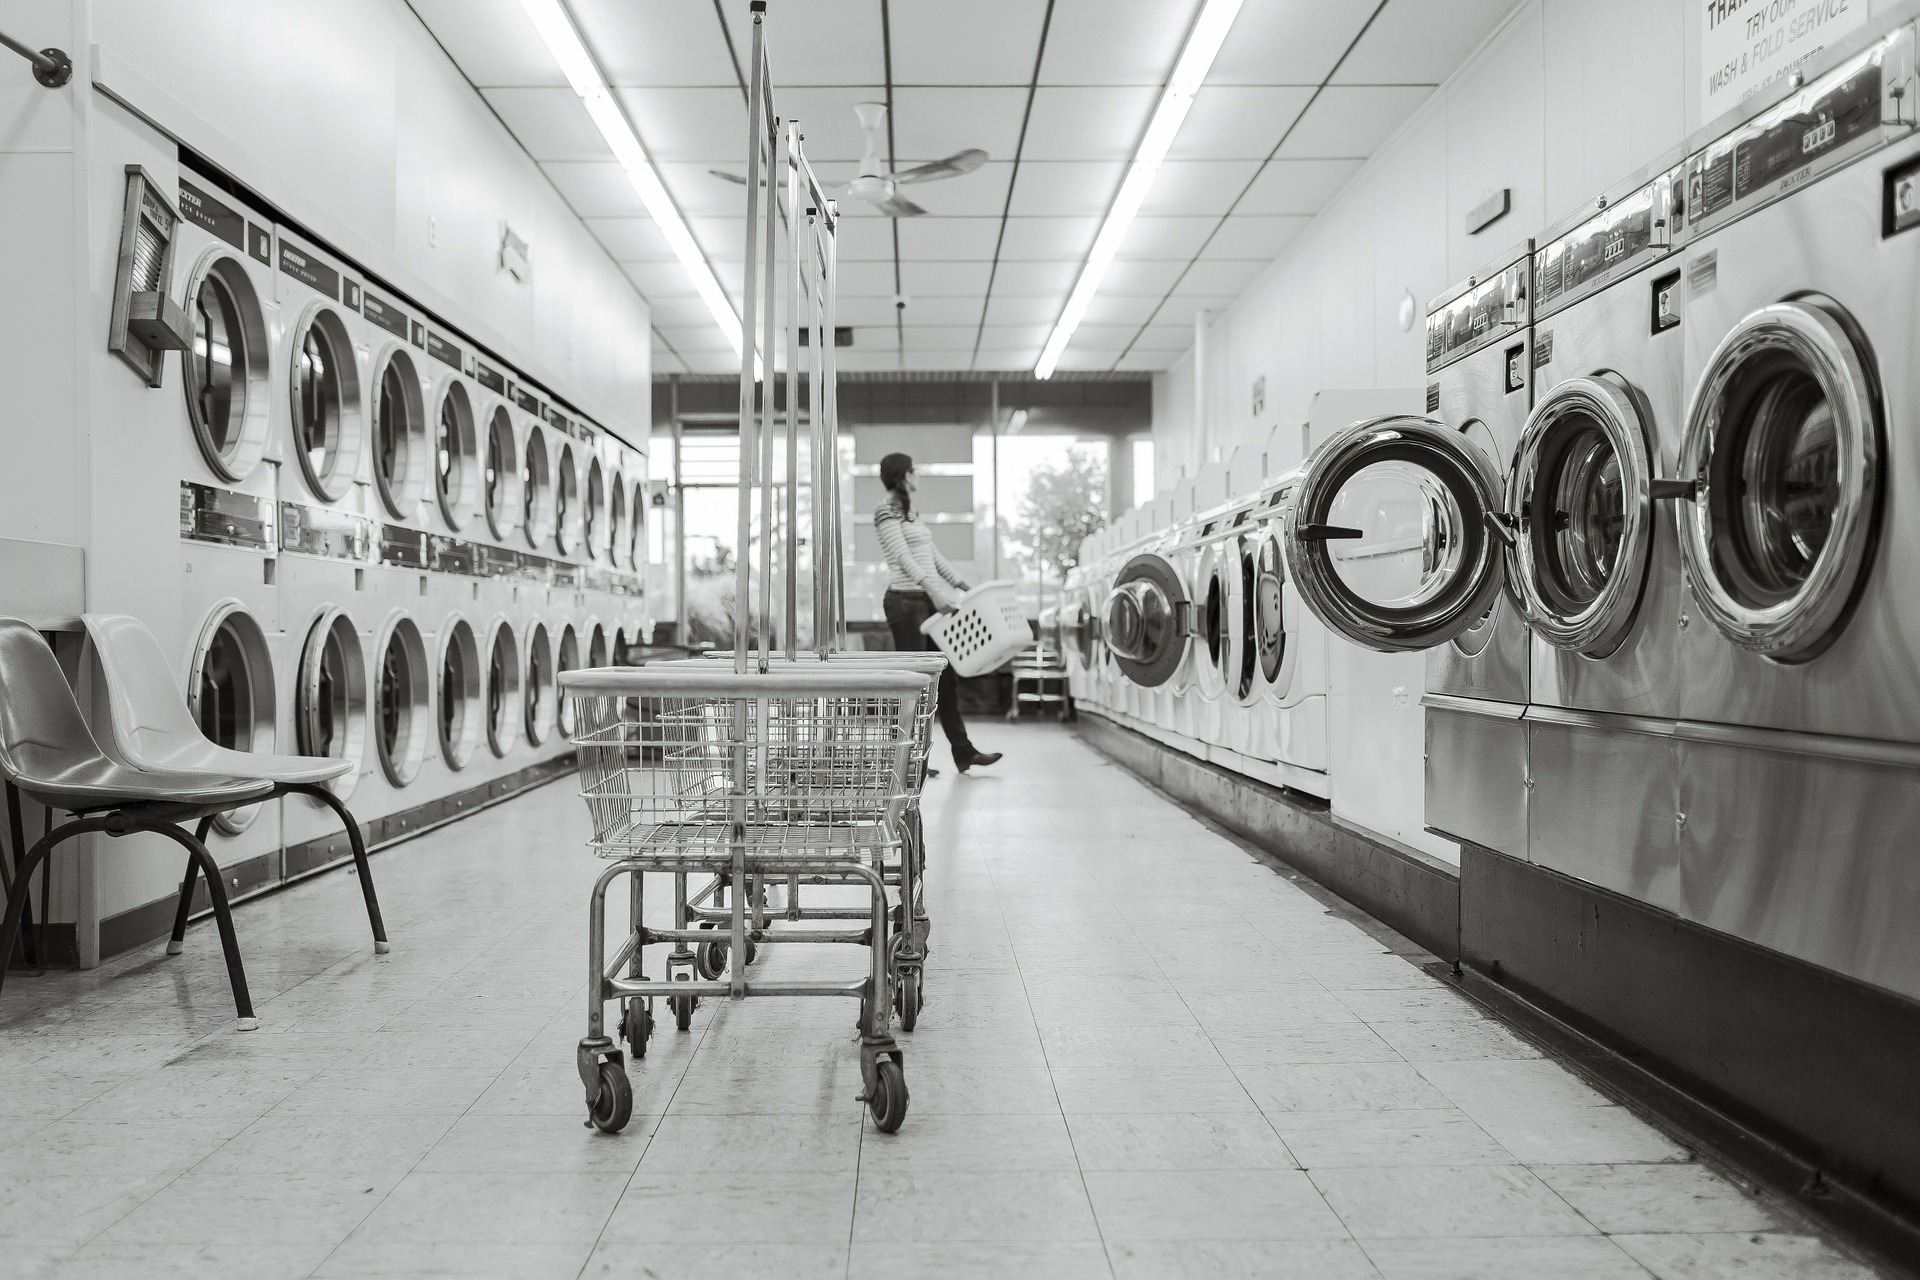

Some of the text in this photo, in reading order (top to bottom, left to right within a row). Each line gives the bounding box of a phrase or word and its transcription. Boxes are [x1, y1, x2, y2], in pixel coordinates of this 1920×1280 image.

[1746, 5, 1769, 41] TRY
[1709, 57, 1738, 97] WASH
[1740, 51, 1749, 75] &
[1751, 27, 1784, 68] FOLD
[1788, 0, 1848, 44] SERVICE
[1780, 166, 1811, 190] DEXTER
[179, 188, 202, 207] EXTER
[185, 562, 193, 574] 20
